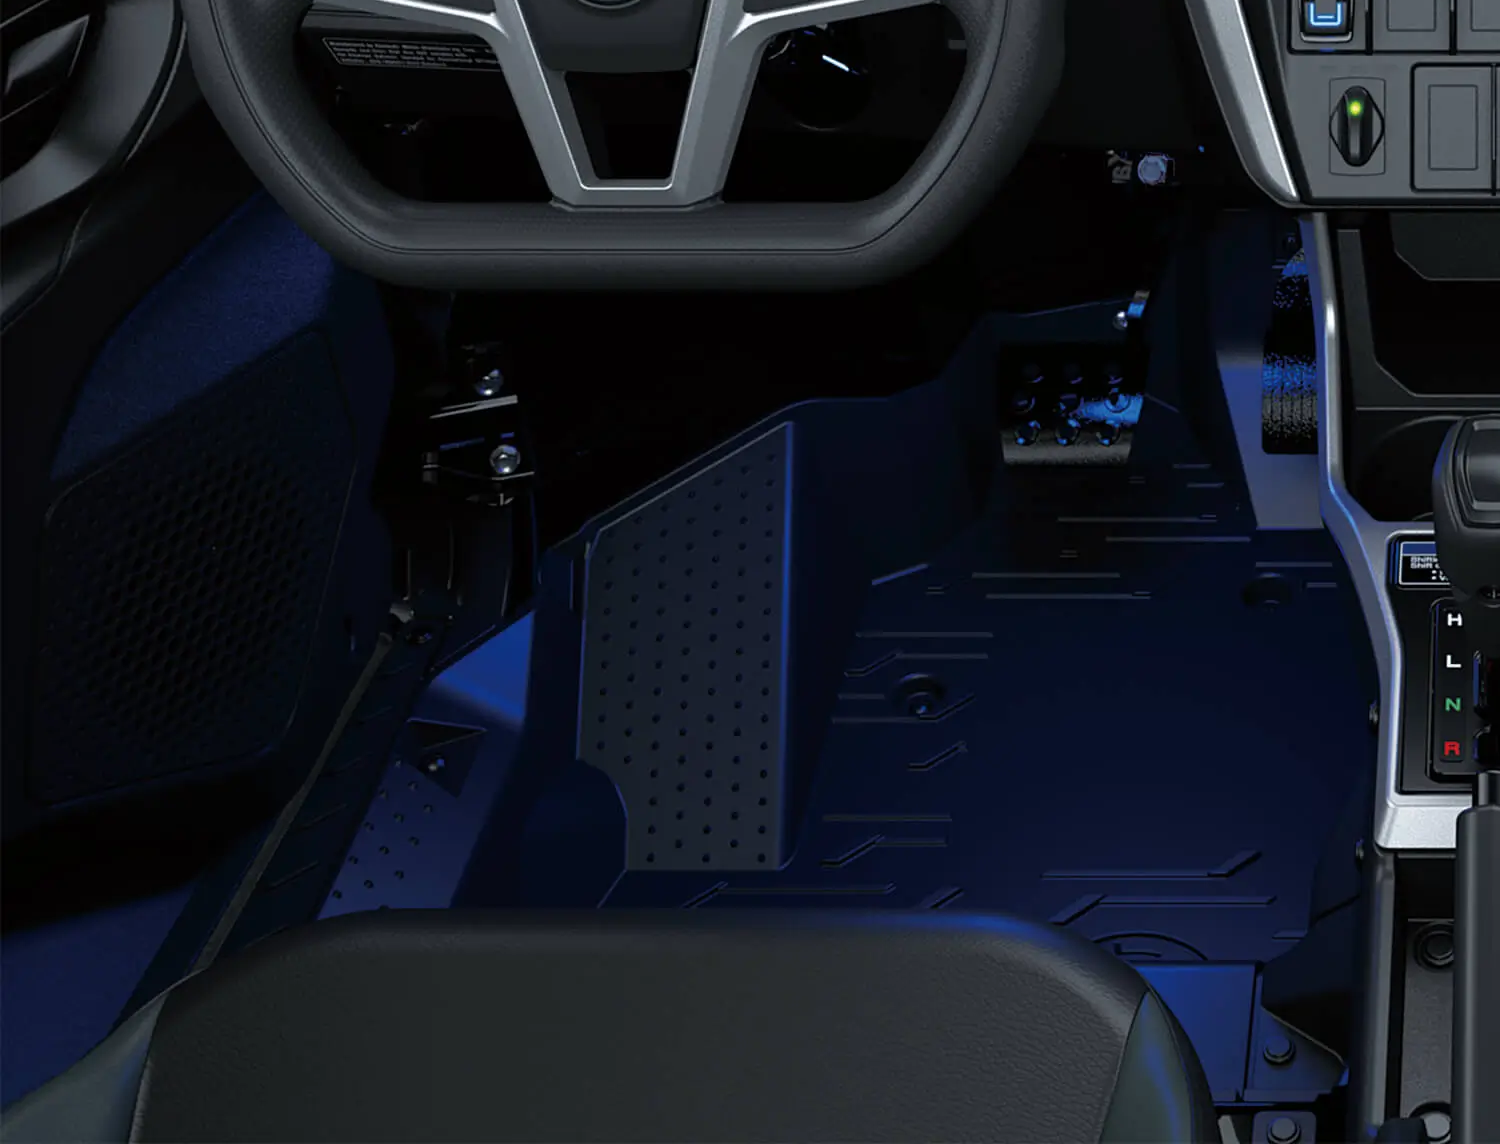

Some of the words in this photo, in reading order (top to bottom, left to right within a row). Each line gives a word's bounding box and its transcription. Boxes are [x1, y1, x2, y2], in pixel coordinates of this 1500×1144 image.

[1447, 613, 1463, 627] H
[1446, 654, 1462, 668] L
[1445, 697, 1461, 711] N
[1444, 741, 1460, 756] R
